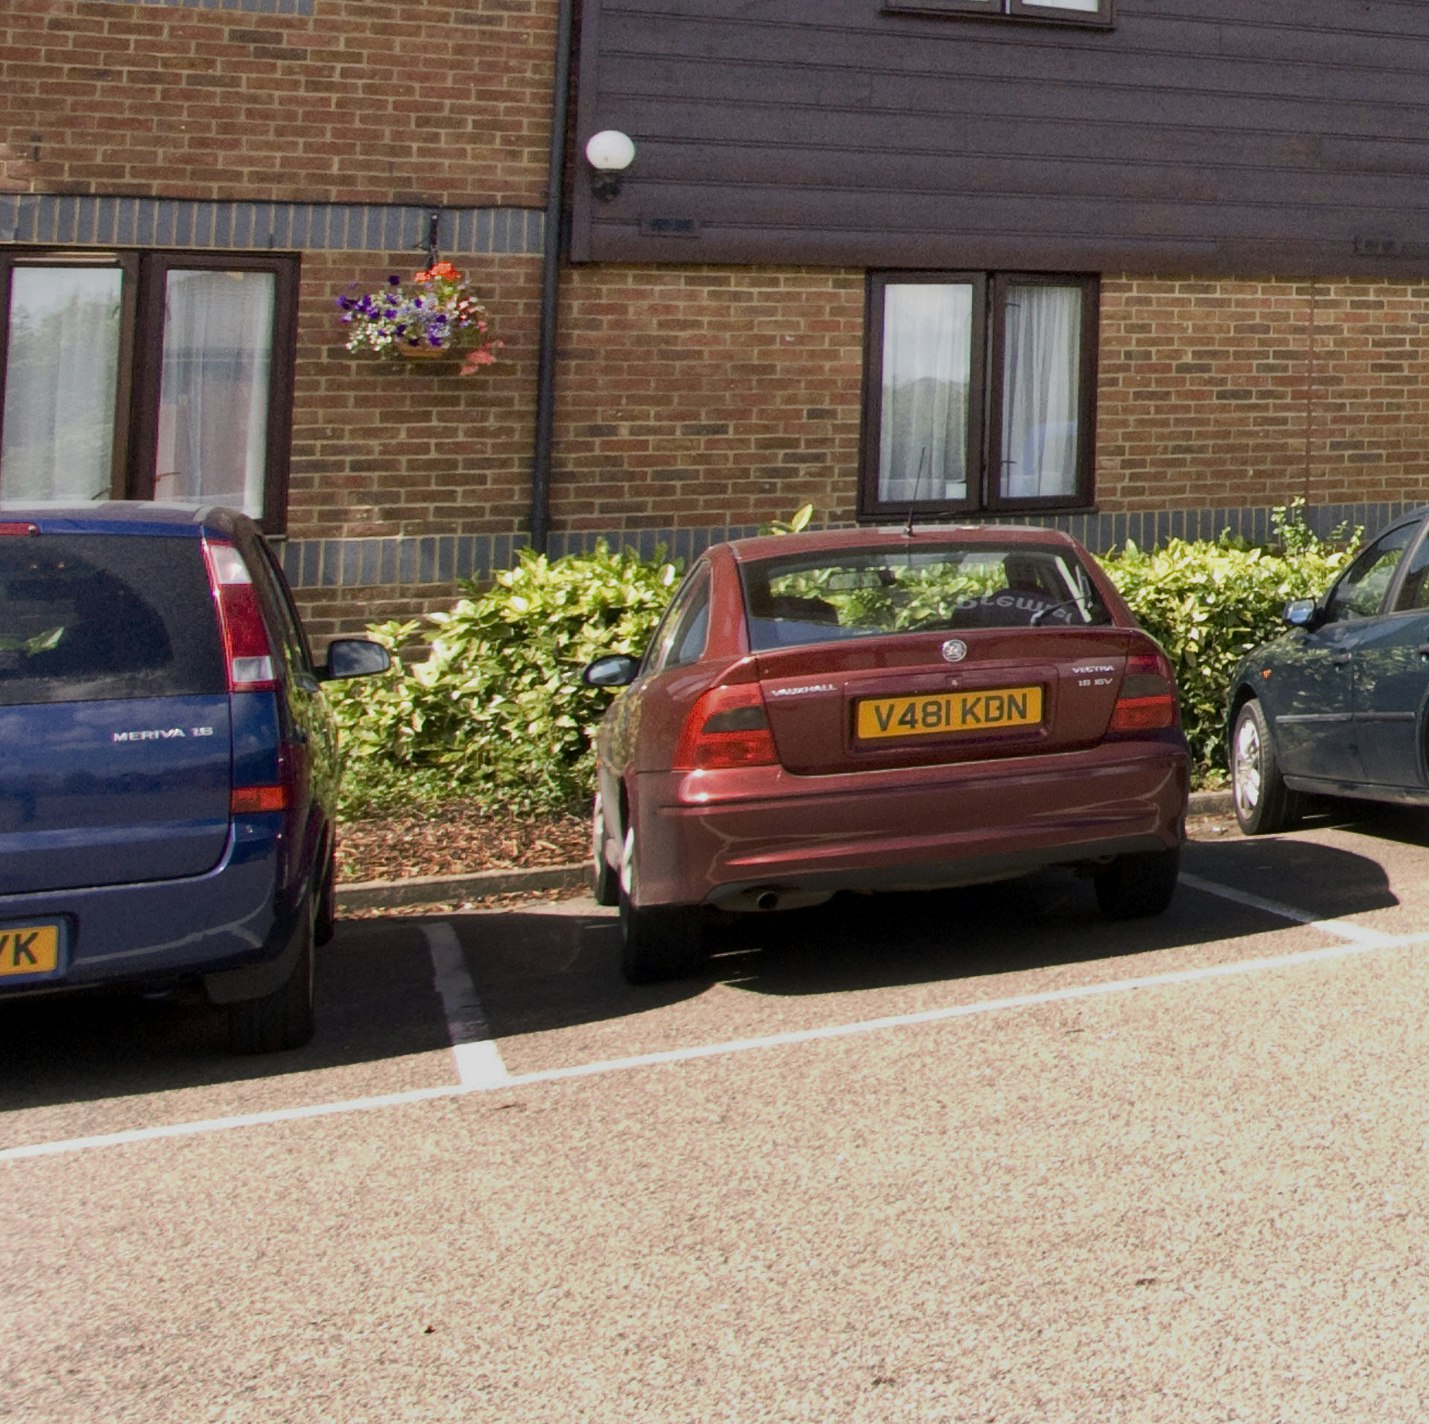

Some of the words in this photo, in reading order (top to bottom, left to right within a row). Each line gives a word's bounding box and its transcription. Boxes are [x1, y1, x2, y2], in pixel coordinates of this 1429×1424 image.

[874, 699, 951, 732] V481
[961, 692, 1028, 725] KDN
[113, 727, 186, 743] MERIVA
